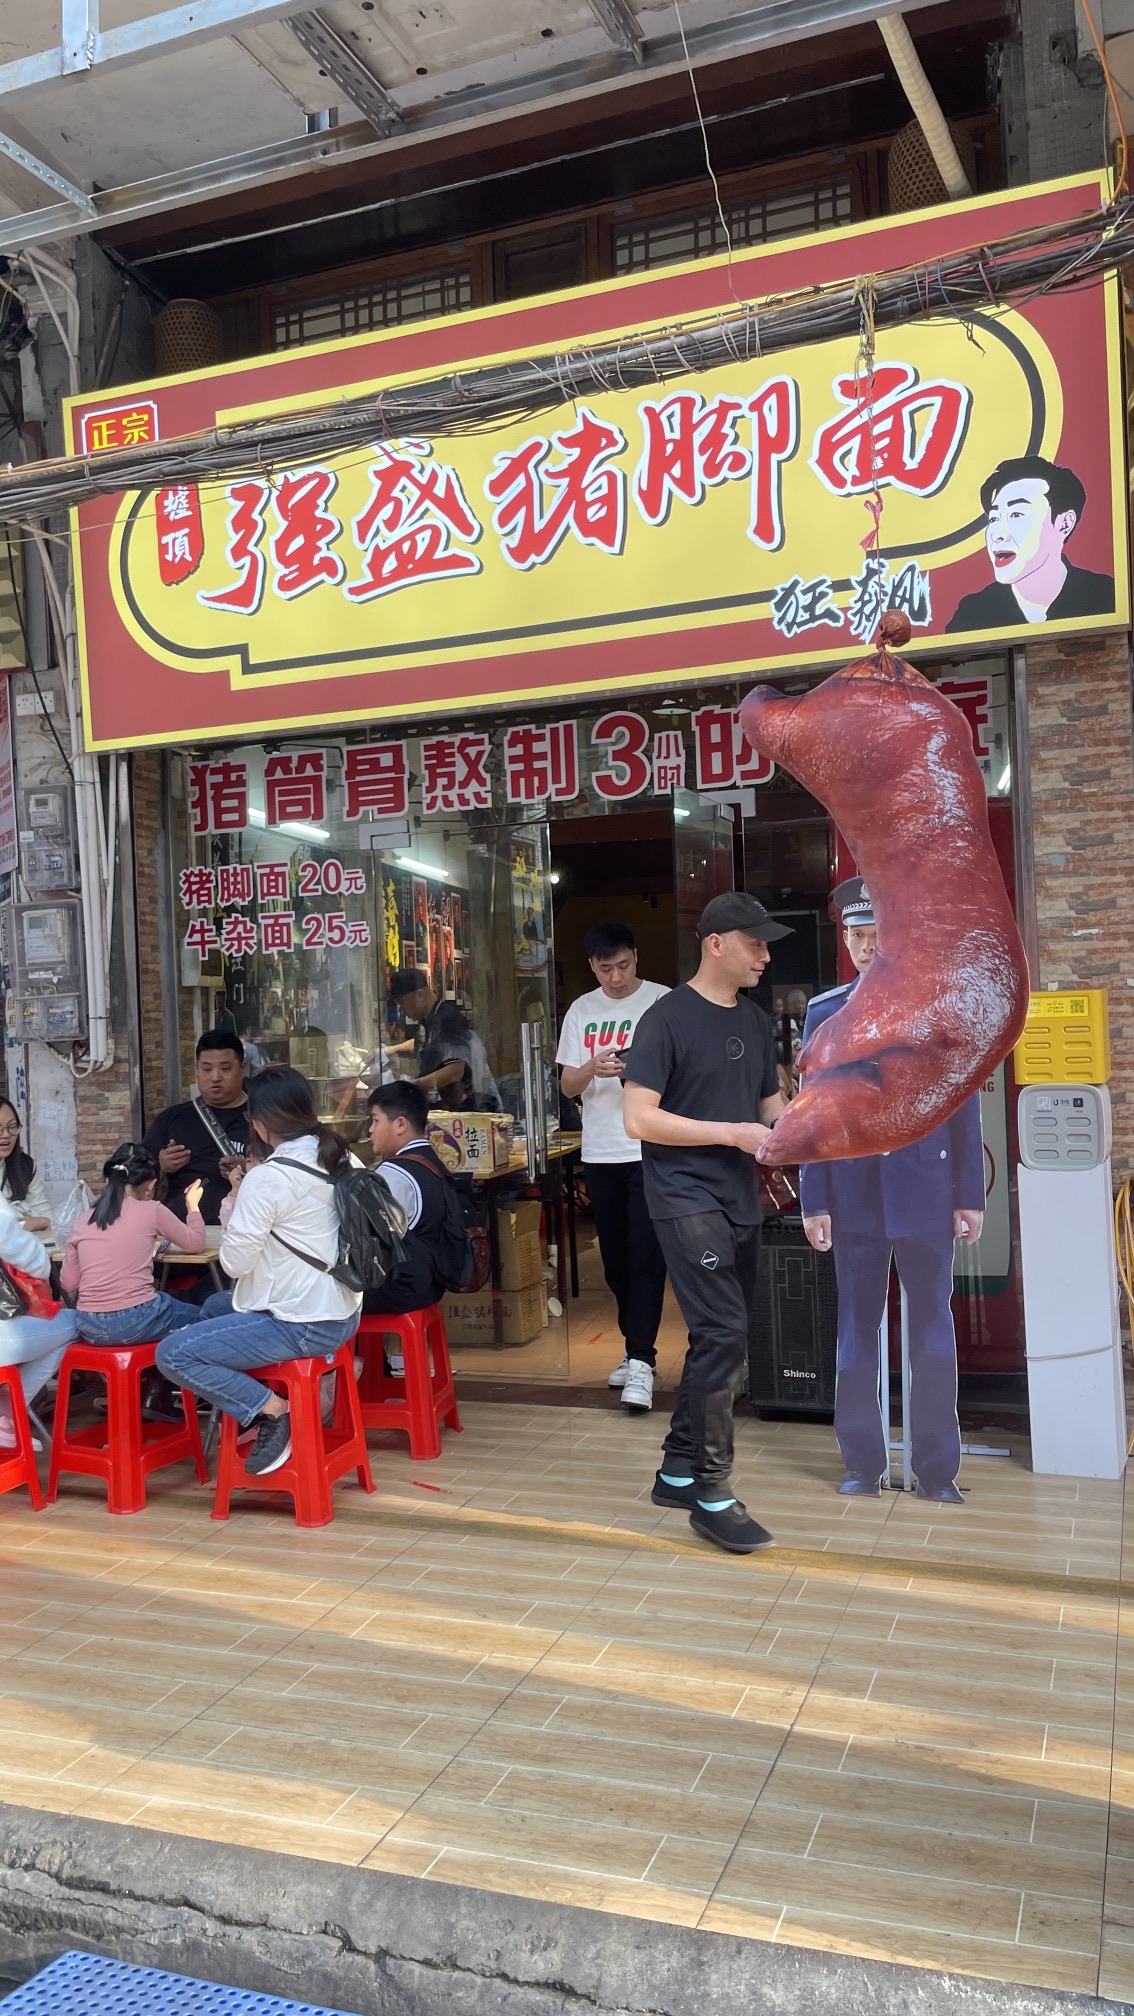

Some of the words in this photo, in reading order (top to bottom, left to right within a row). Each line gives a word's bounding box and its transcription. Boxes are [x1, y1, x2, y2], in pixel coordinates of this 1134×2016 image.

[92, 412, 150, 450] 正宗
[179, 861, 290, 909] 猪脚面
[299, 858, 367, 897] 20元
[185, 911, 296, 960] 牛杂面
[302, 911, 371, 950] 25元
[465, 1127, 480, 1159] 拉面
[480, 1128, 488, 1156] RAMEN
[783, 1369, 817, 1379] Shinco
